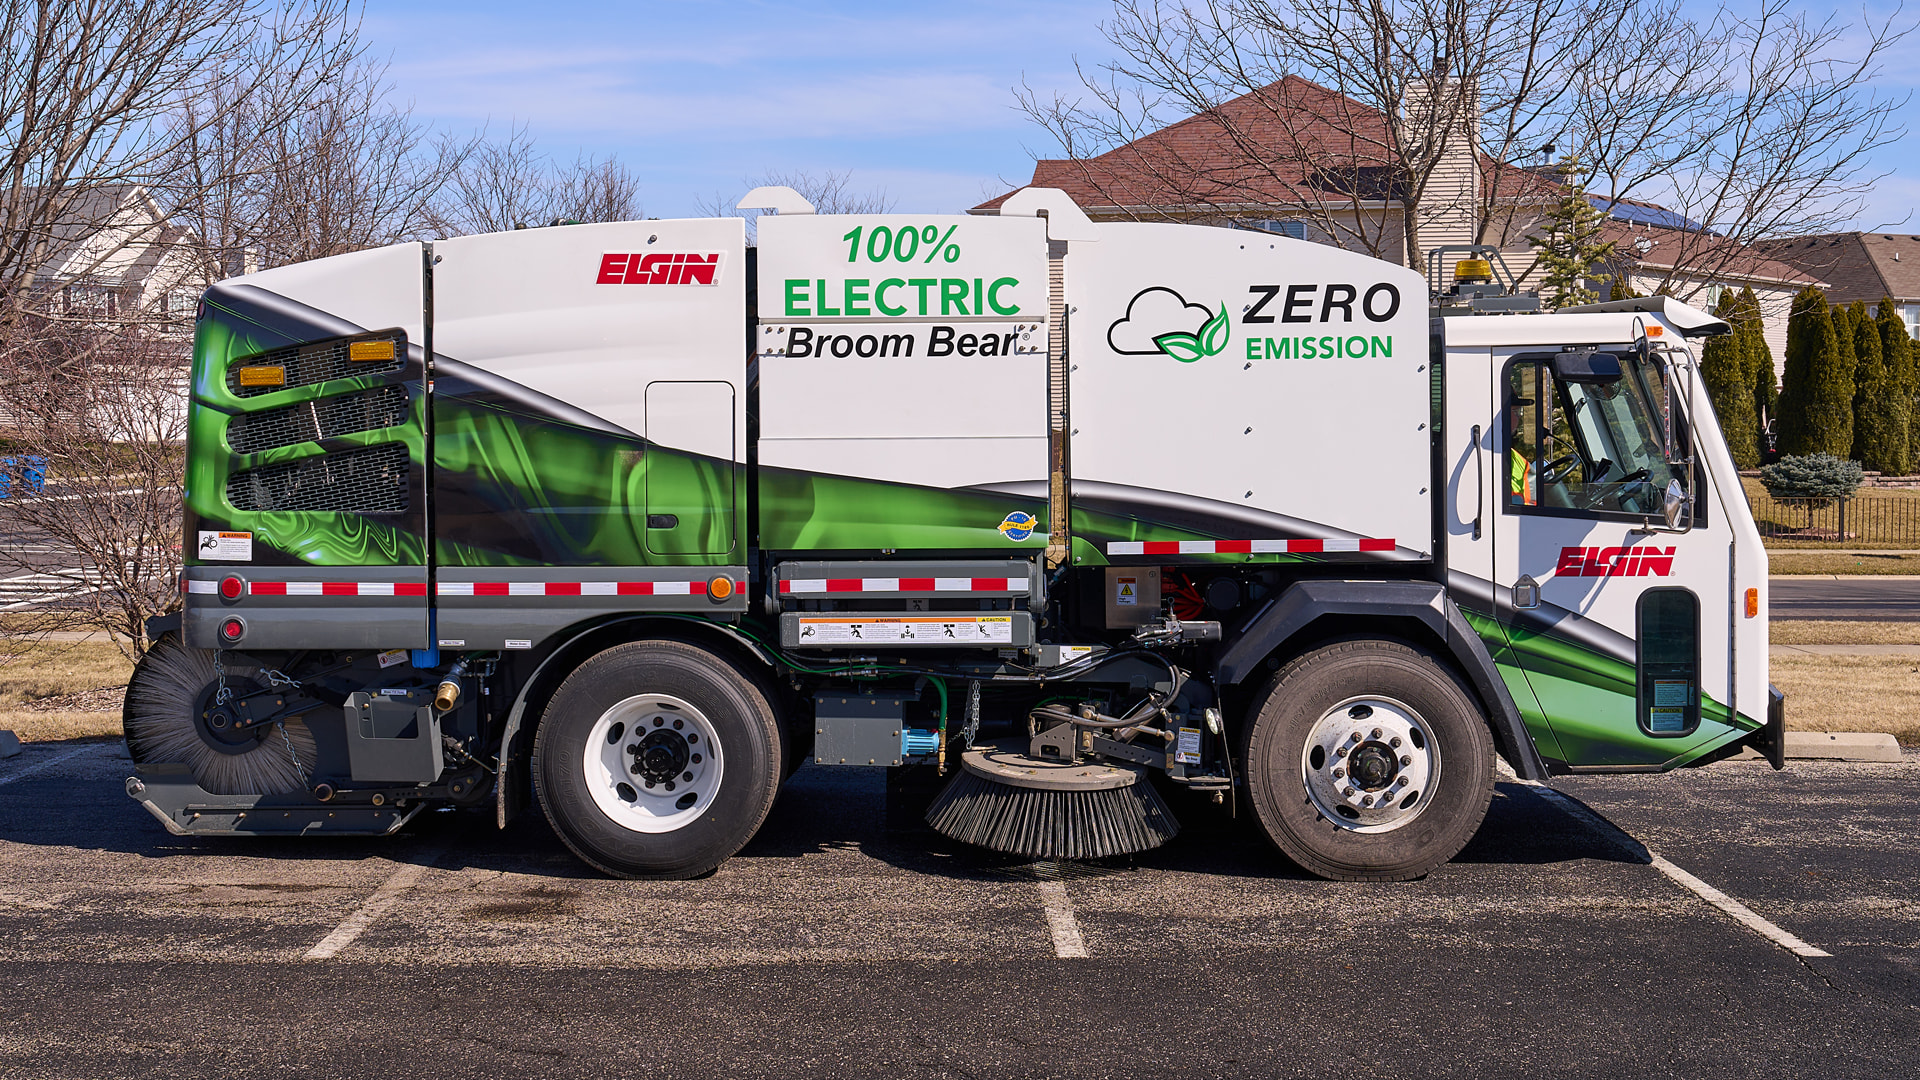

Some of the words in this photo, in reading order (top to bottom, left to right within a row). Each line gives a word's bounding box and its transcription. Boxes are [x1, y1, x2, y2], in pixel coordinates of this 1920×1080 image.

[843, 225, 960, 263] 100%
[596, 253, 719, 285] ELGIN
[785, 277, 1021, 316] ELECTRIC
[1242, 282, 1401, 324] ZERO
[785, 327, 915, 358] Broom
[927, 326, 1019, 357] Bear
[1246, 336, 1392, 360] EMISSION
[1555, 546, 1677, 577] ELGIN
